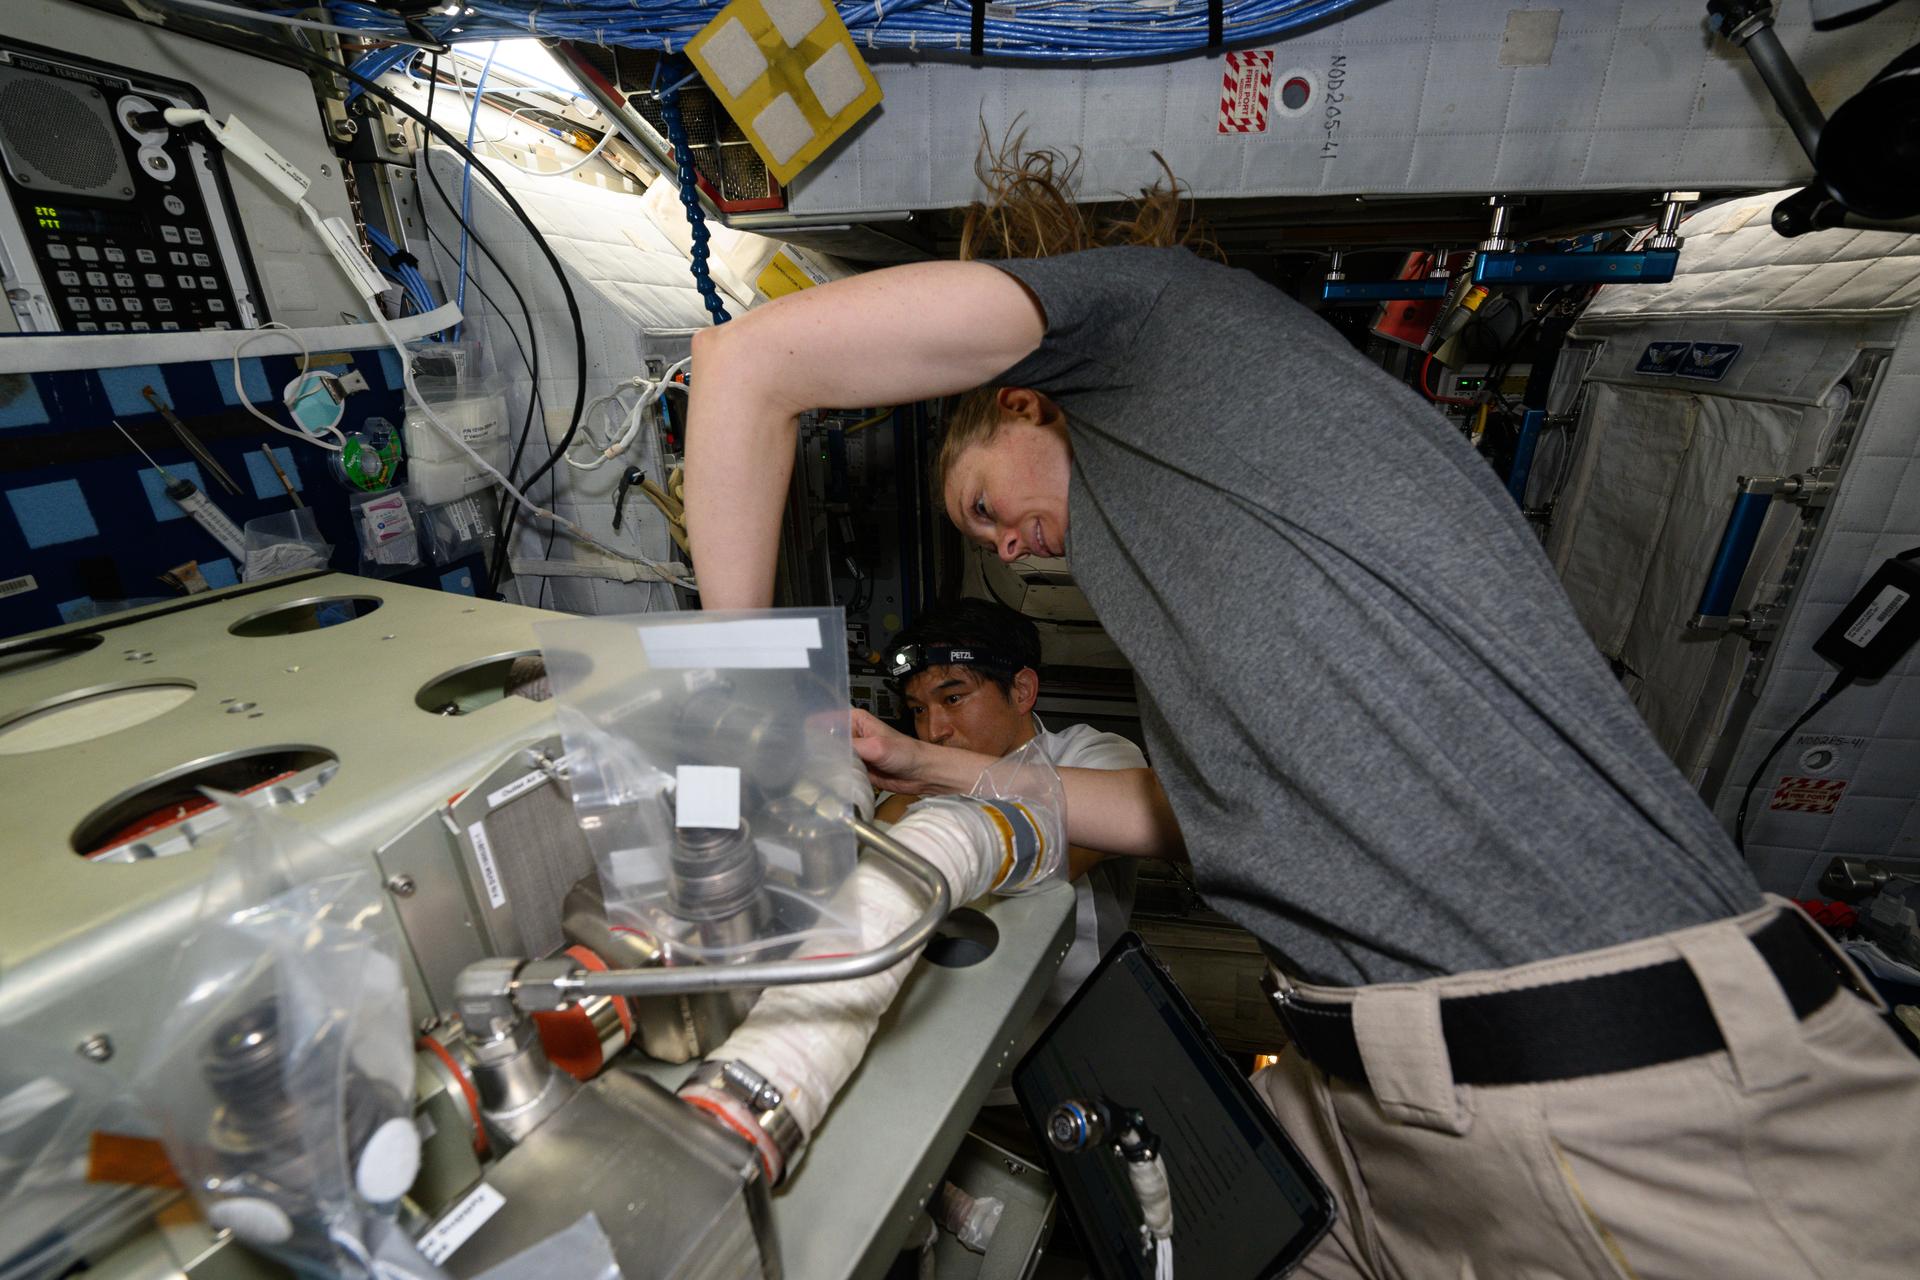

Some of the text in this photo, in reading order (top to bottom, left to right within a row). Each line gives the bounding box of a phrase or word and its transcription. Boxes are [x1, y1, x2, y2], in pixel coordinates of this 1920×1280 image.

[20, 59, 125, 90] AUDIO TERMINAL UNIT
[1242, 69, 1253, 115] FIRE PORT
[168, 200, 182, 209] PTT
[39, 218, 60, 229] PTT
[950, 651, 974, 662] PETZL
